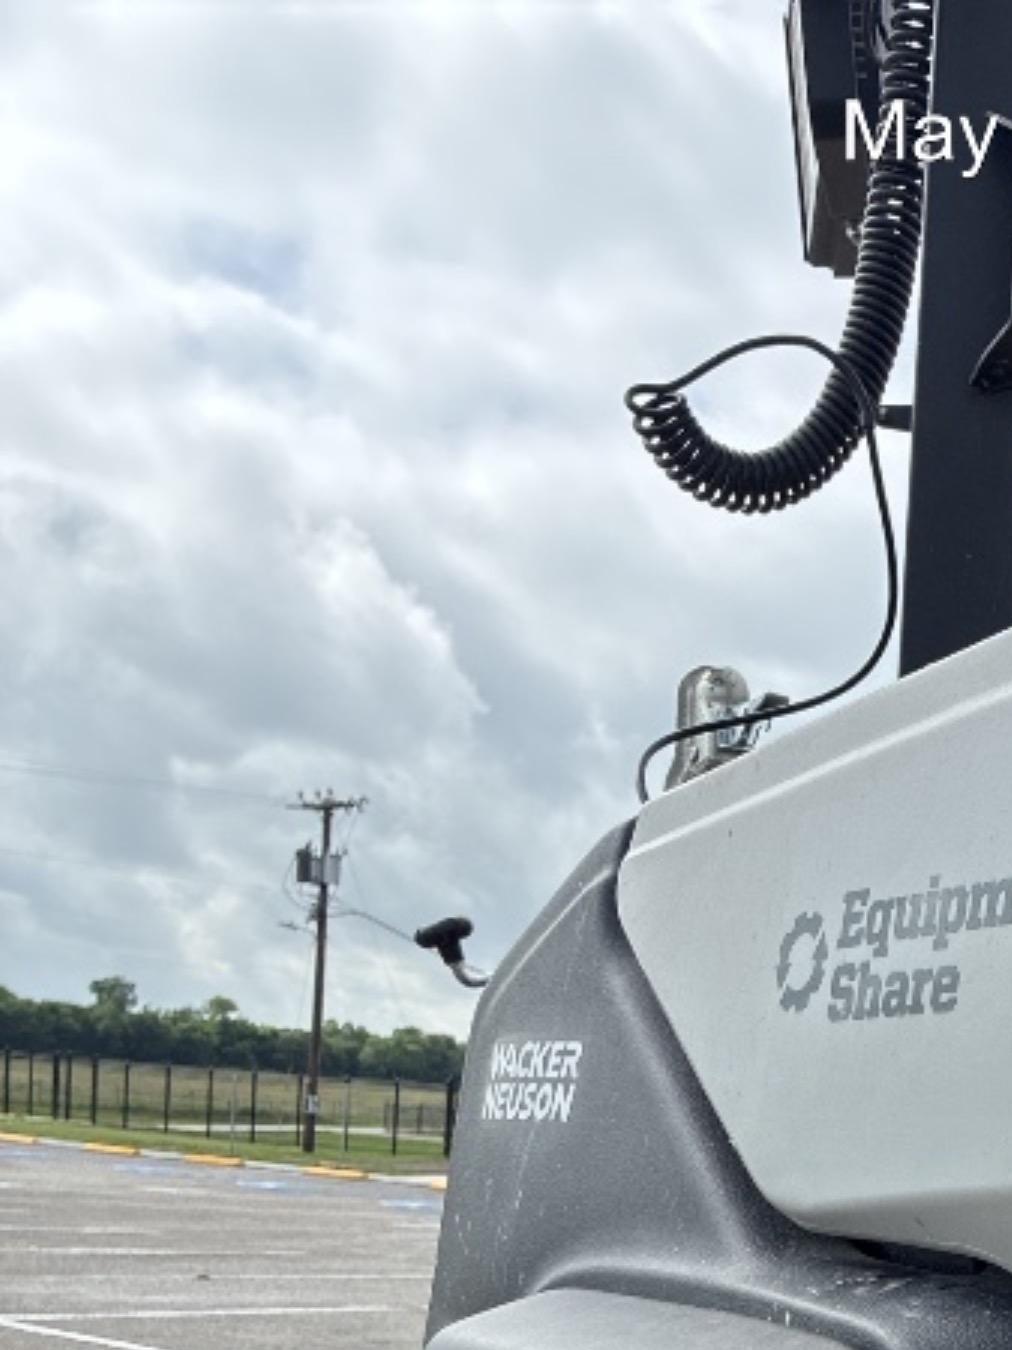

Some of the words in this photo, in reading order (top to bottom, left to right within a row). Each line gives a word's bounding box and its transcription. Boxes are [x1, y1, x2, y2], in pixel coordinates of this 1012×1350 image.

[827, 960, 960, 1022] Share
[491, 1040, 583, 1080] WACKER
[482, 1082, 576, 1122] NEUSON
